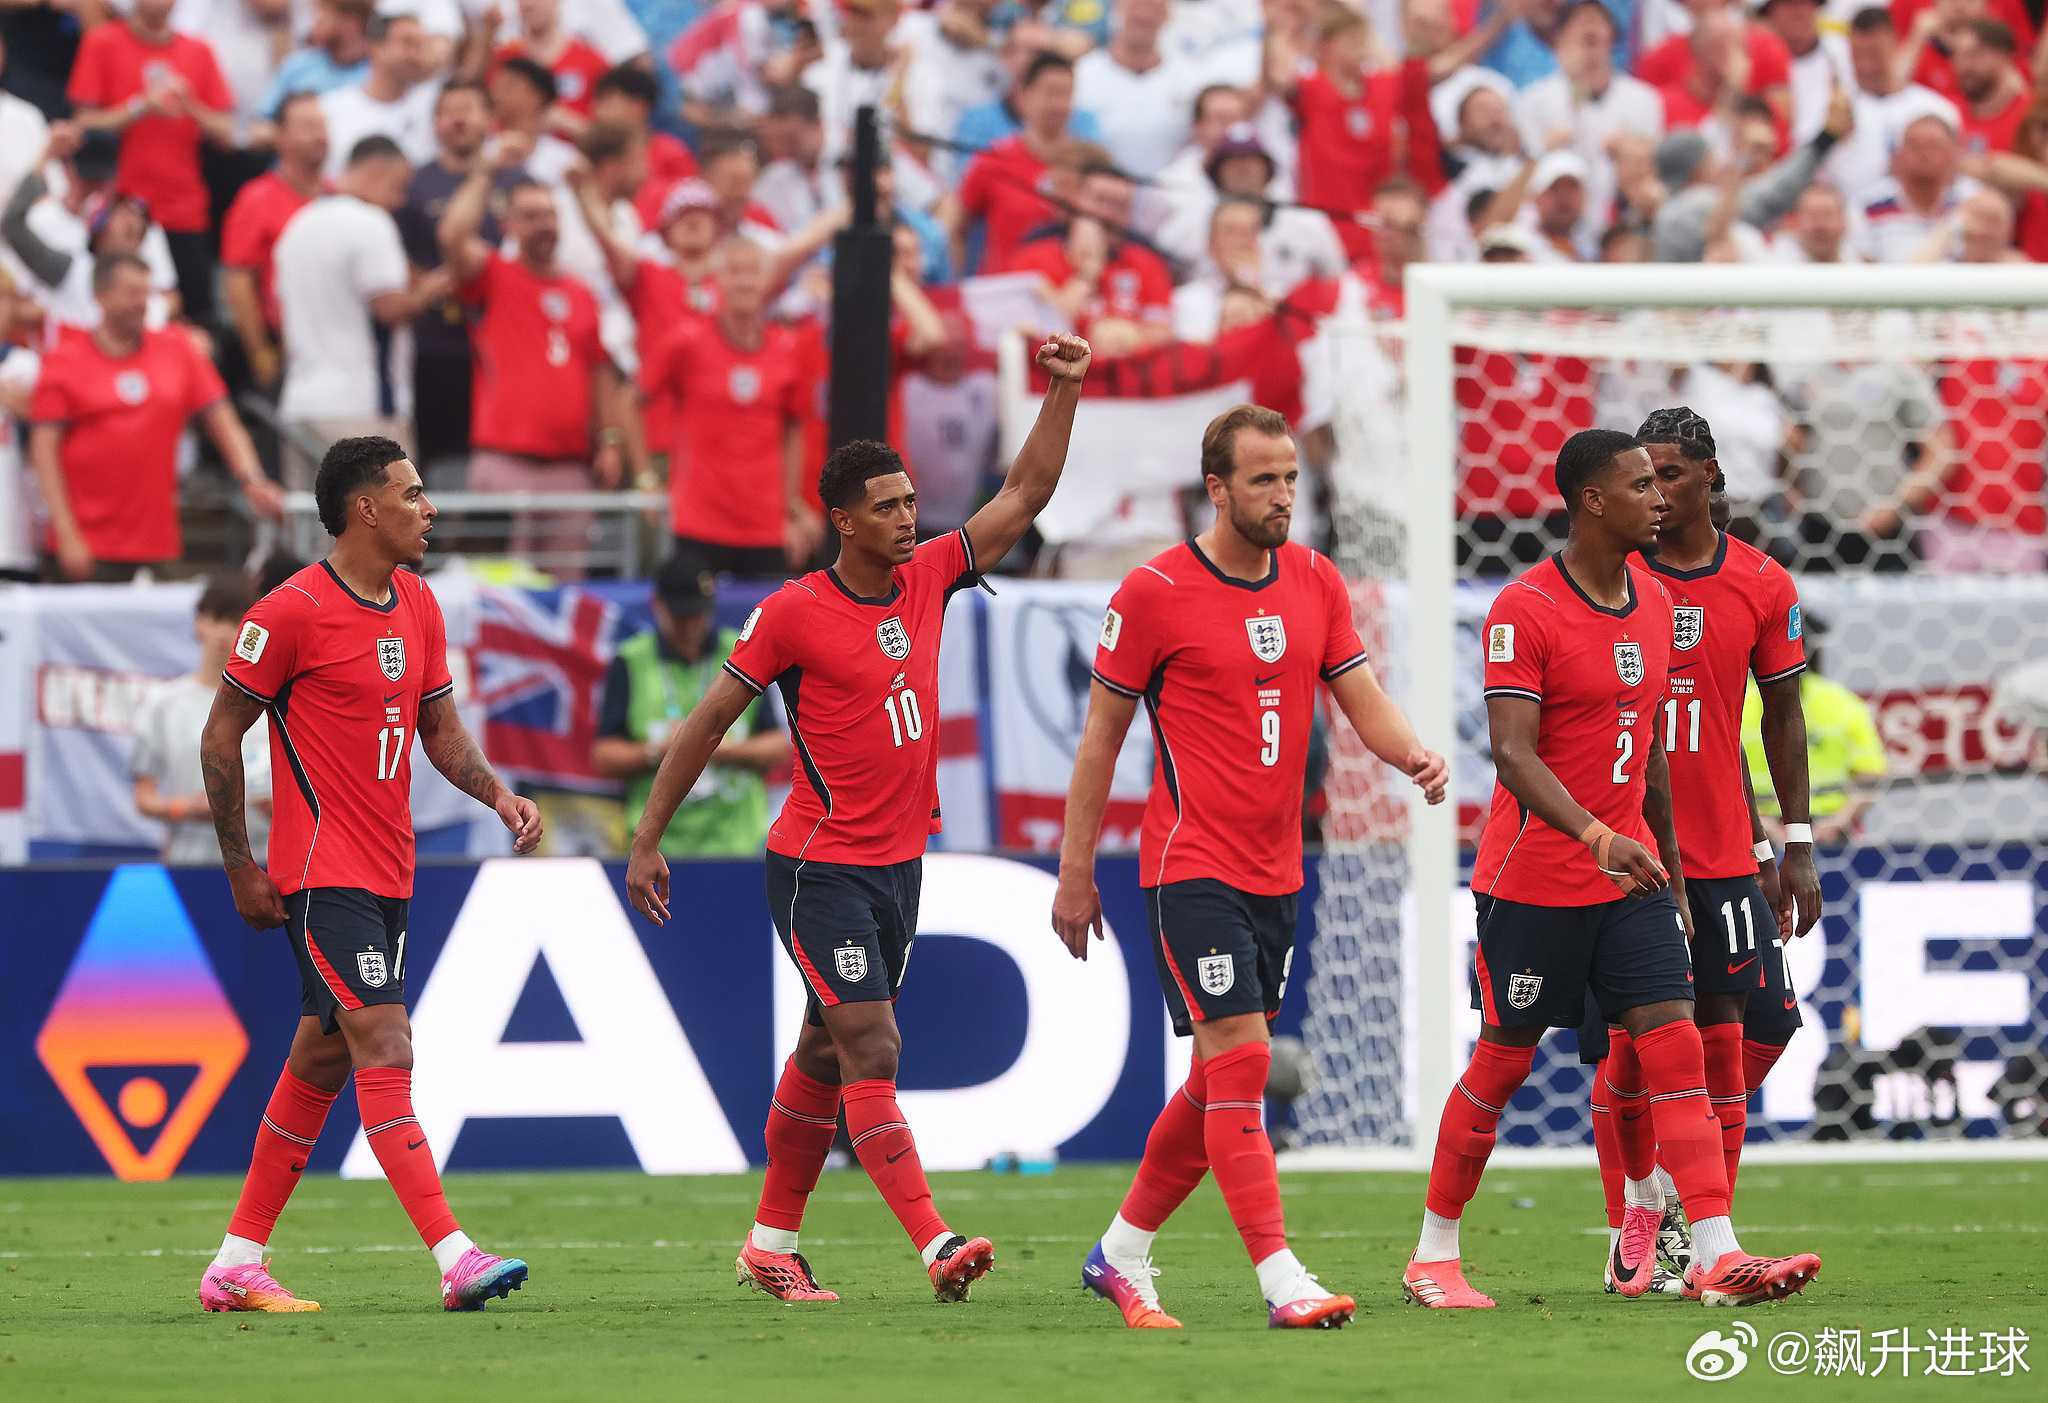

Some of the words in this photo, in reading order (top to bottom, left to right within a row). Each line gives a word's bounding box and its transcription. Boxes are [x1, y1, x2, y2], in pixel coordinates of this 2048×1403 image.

[1670, 678, 1695, 686] PANAMA
[884, 688, 922, 747] 10
[1260, 710, 1280, 767] 9
[1664, 699, 1701, 752] 11
[378, 727, 405, 780] 17
[1612, 730, 1633, 784] 2
[1721, 897, 1756, 954] 11
[340, 855, 1266, 1180] AD
